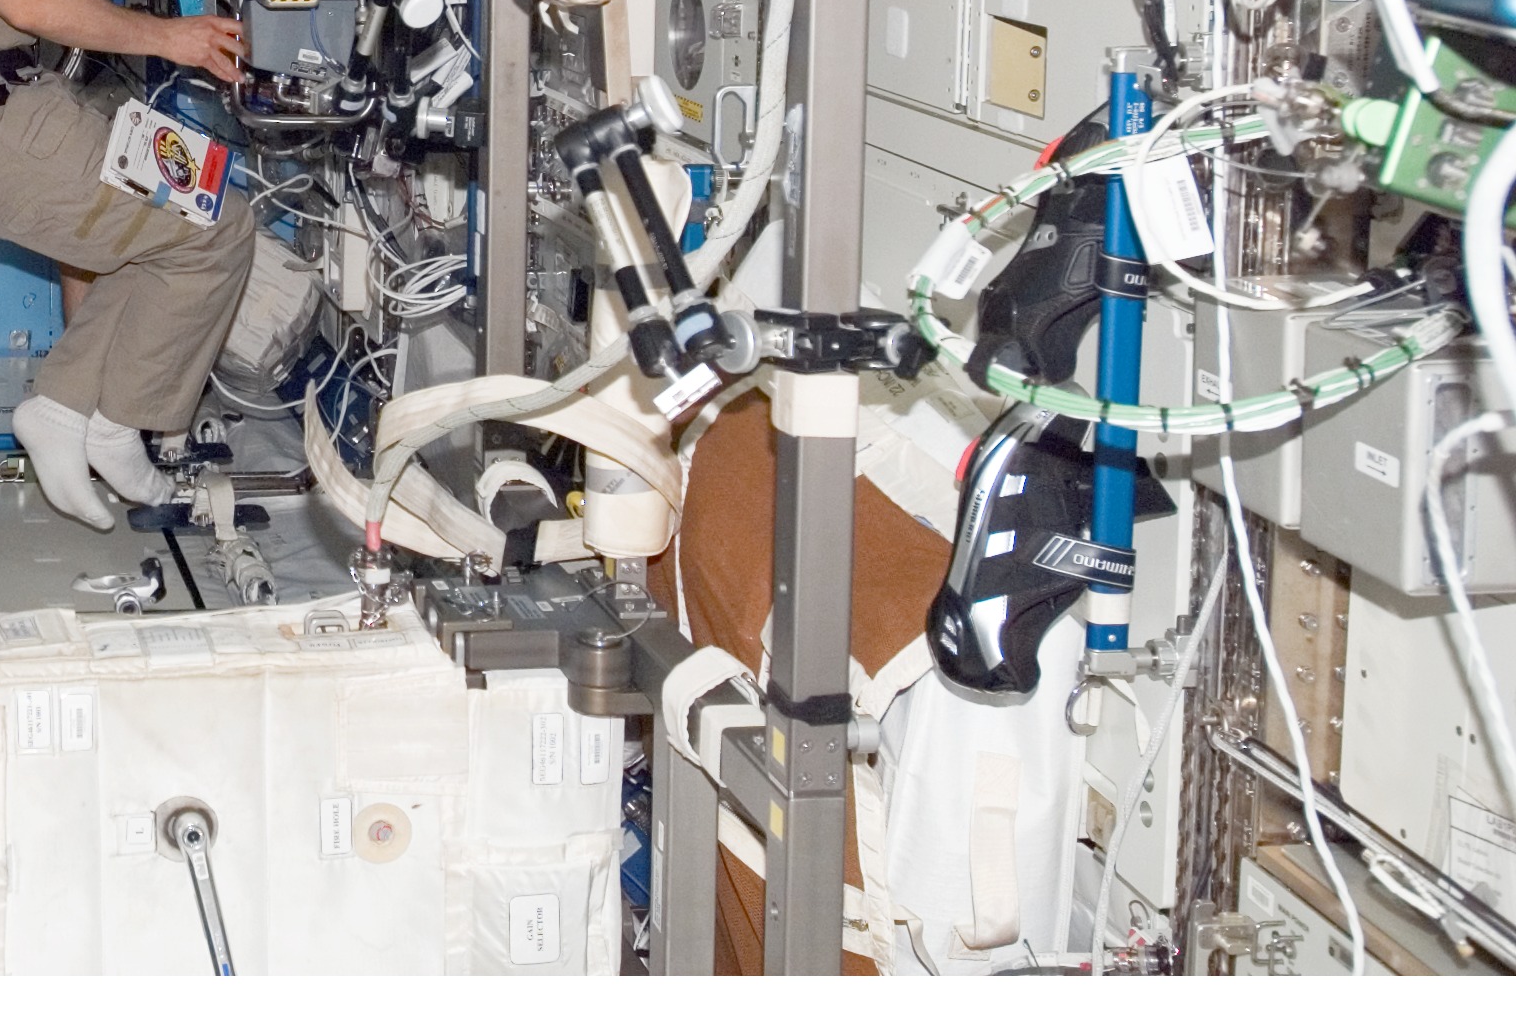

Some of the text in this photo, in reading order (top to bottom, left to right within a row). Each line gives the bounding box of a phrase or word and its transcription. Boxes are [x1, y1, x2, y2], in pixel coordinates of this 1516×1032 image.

[332, 803, 341, 827] HOLE
[525, 919, 534, 941] GAIN
[536, 906, 545, 952] SELECTOR
